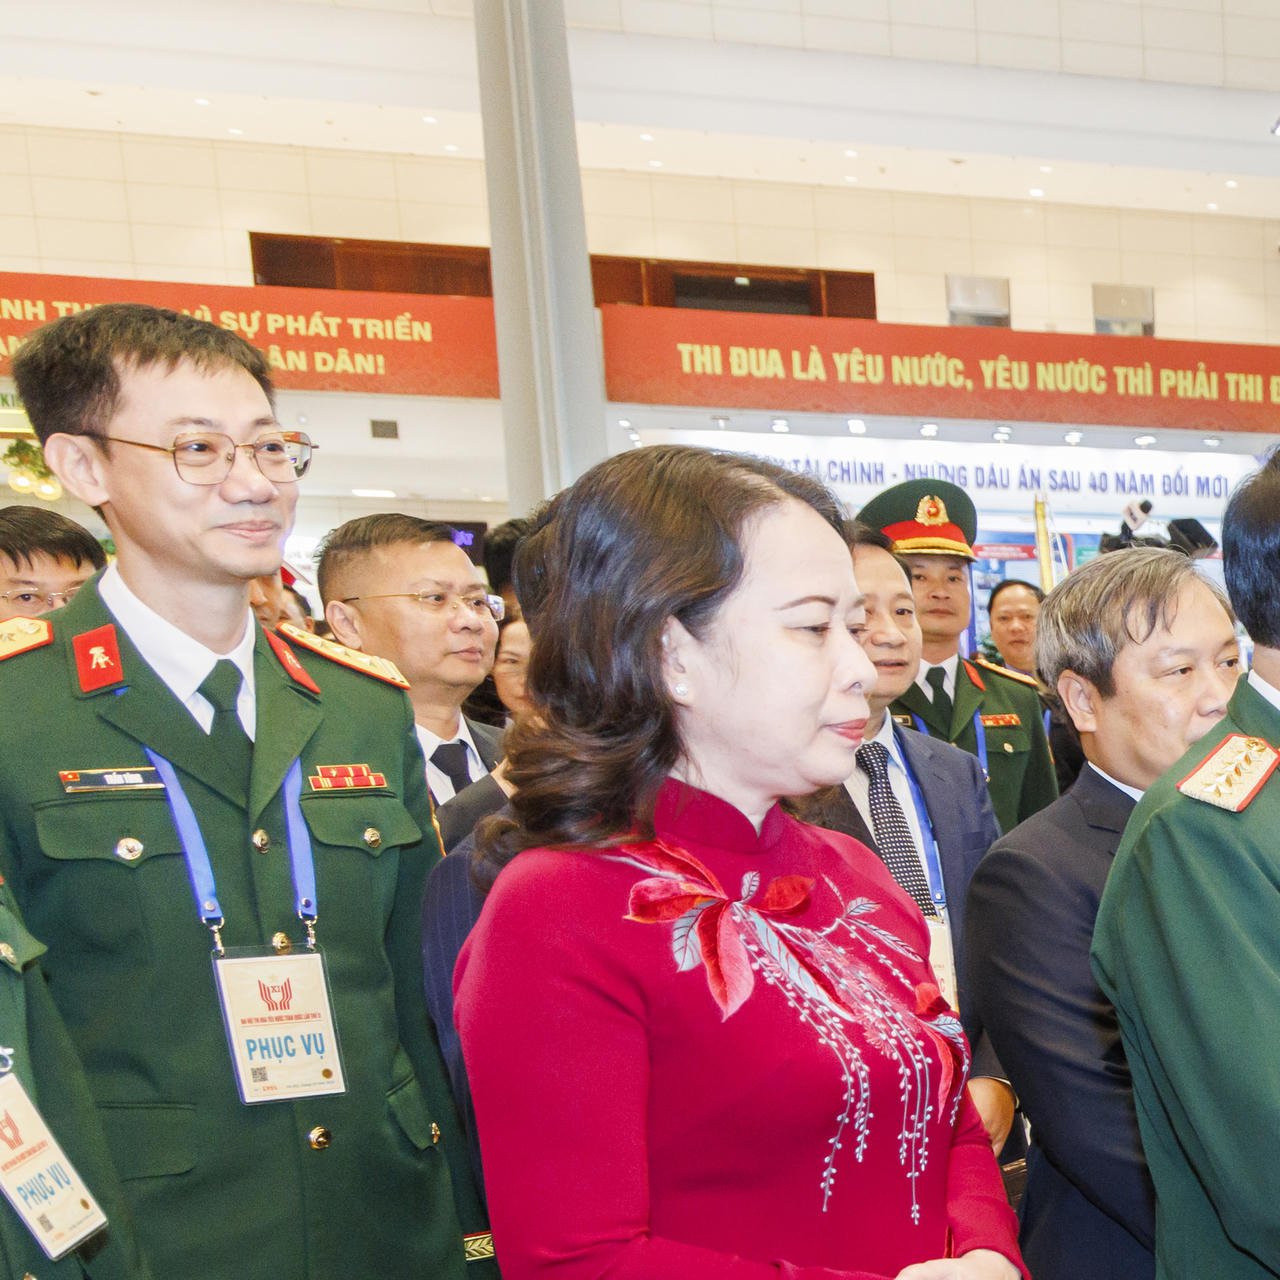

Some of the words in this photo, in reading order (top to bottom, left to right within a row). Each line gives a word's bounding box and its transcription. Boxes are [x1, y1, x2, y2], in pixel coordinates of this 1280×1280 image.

[0, 298, 46, 321] NH
[220, 310, 262, 339] SỰ
[266, 312, 341, 338] PHÁT
[347, 311, 432, 342] TRIỂN
[267, 345, 307, 372] ÂN
[314, 348, 386, 375] DÂN!
[677, 343, 722, 375] THI
[729, 346, 785, 379] ĐUA
[792, 345, 826, 381] LÀ
[832, 347, 884, 384] YÊU
[892, 351, 973, 392] NƯỚC,
[979, 354, 1029, 390] YÊU
[1036, 357, 1107, 394] NƯỚC
[1113, 362, 1154, 397] THÌ
[1160, 362, 1218, 399] PHẢI
[1225, 372, 1264, 402] THI
[828, 456, 885, 485] CHÍNH
[1050, 469, 1081, 492] SAU
[1089, 471, 1108, 493] 40
[1115, 469, 1155, 496] NĂM
[1162, 465, 1189, 497] ĐỔI
[1196, 473, 1228, 498] MỚI
[246, 1035, 296, 1064] PHỤC
[300, 1032, 326, 1060] VỤ
[16, 1173, 55, 1210] PHỤC
[46, 1162, 74, 1191] VỤ
